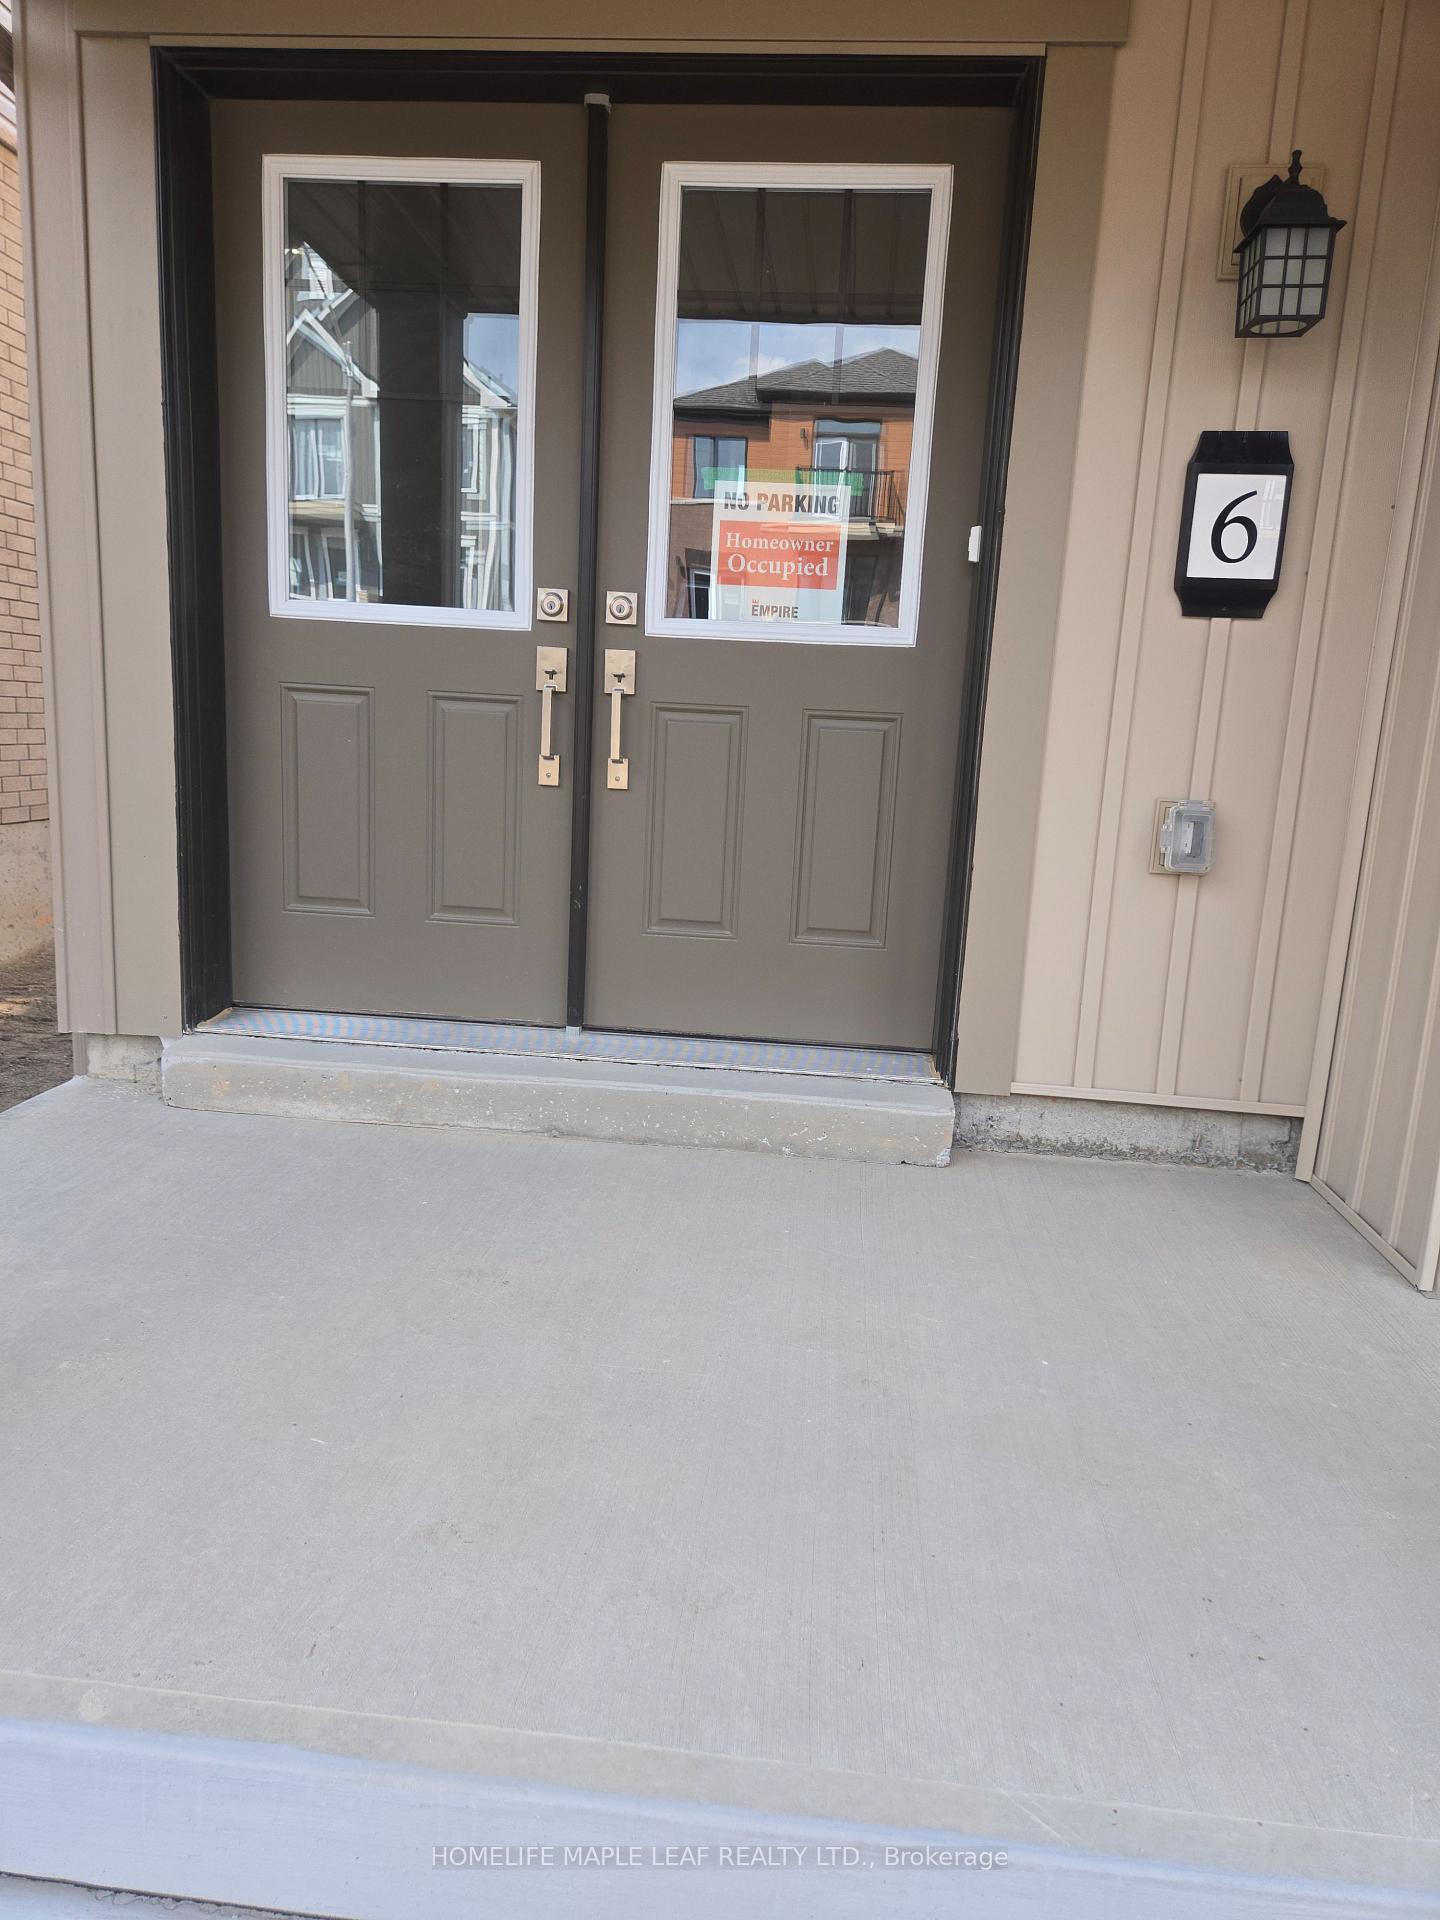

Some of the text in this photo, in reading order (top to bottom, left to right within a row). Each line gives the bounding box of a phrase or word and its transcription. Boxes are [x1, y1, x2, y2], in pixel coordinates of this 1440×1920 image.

[723, 491, 840, 514] NO PARKING
[1211, 490, 1258, 564] 6
[726, 532, 834, 552] Homeowner
[727, 553, 829, 580] Occupied
[751, 604, 799, 619] EMPIRE
